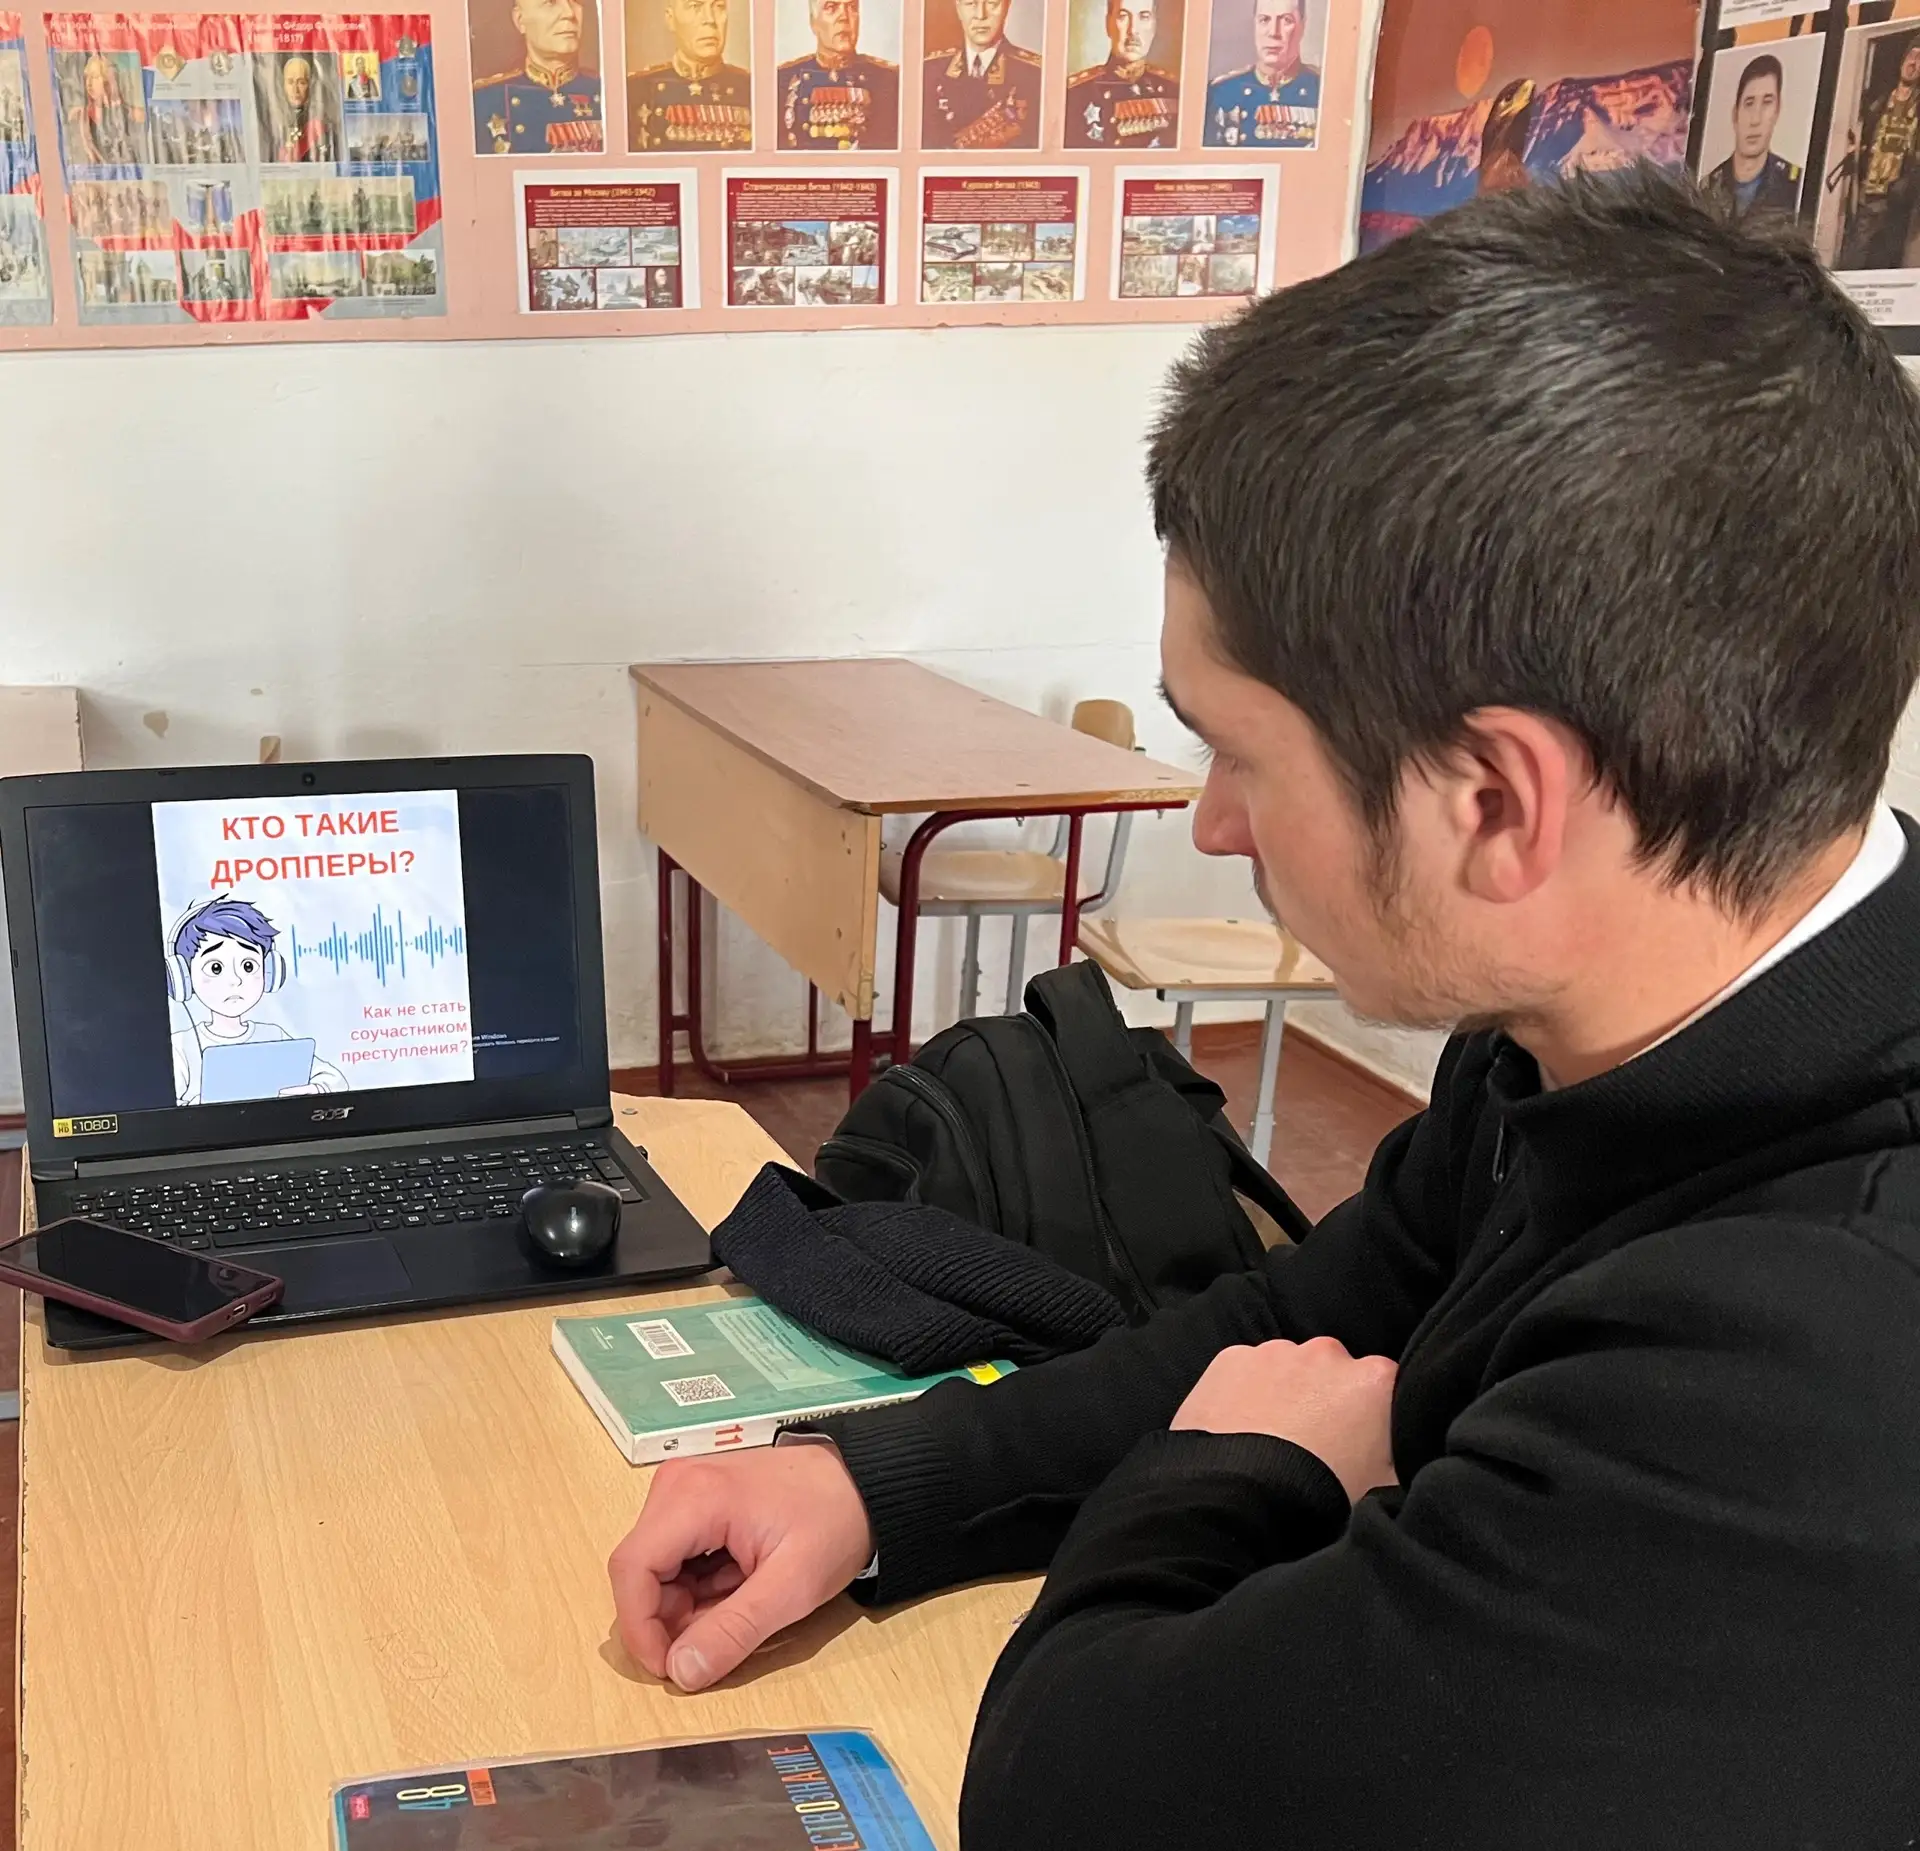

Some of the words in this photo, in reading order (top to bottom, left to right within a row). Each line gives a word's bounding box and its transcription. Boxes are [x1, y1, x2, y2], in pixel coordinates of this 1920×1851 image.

[222, 815, 285, 841] КТО
[295, 810, 399, 837] ТАКИЕ
[210, 850, 415, 890] ДРОППЕРЫ?
[363, 1005, 392, 1019] Как
[397, 1005, 416, 1017] не
[421, 1001, 466, 1015] стать
[350, 1022, 468, 1043] соучастником
[341, 1040, 468, 1065] преступления?
[311, 1106, 354, 1120] acer
[715, 1424, 744, 1447] 11
[396, 1783, 468, 1811] 48
